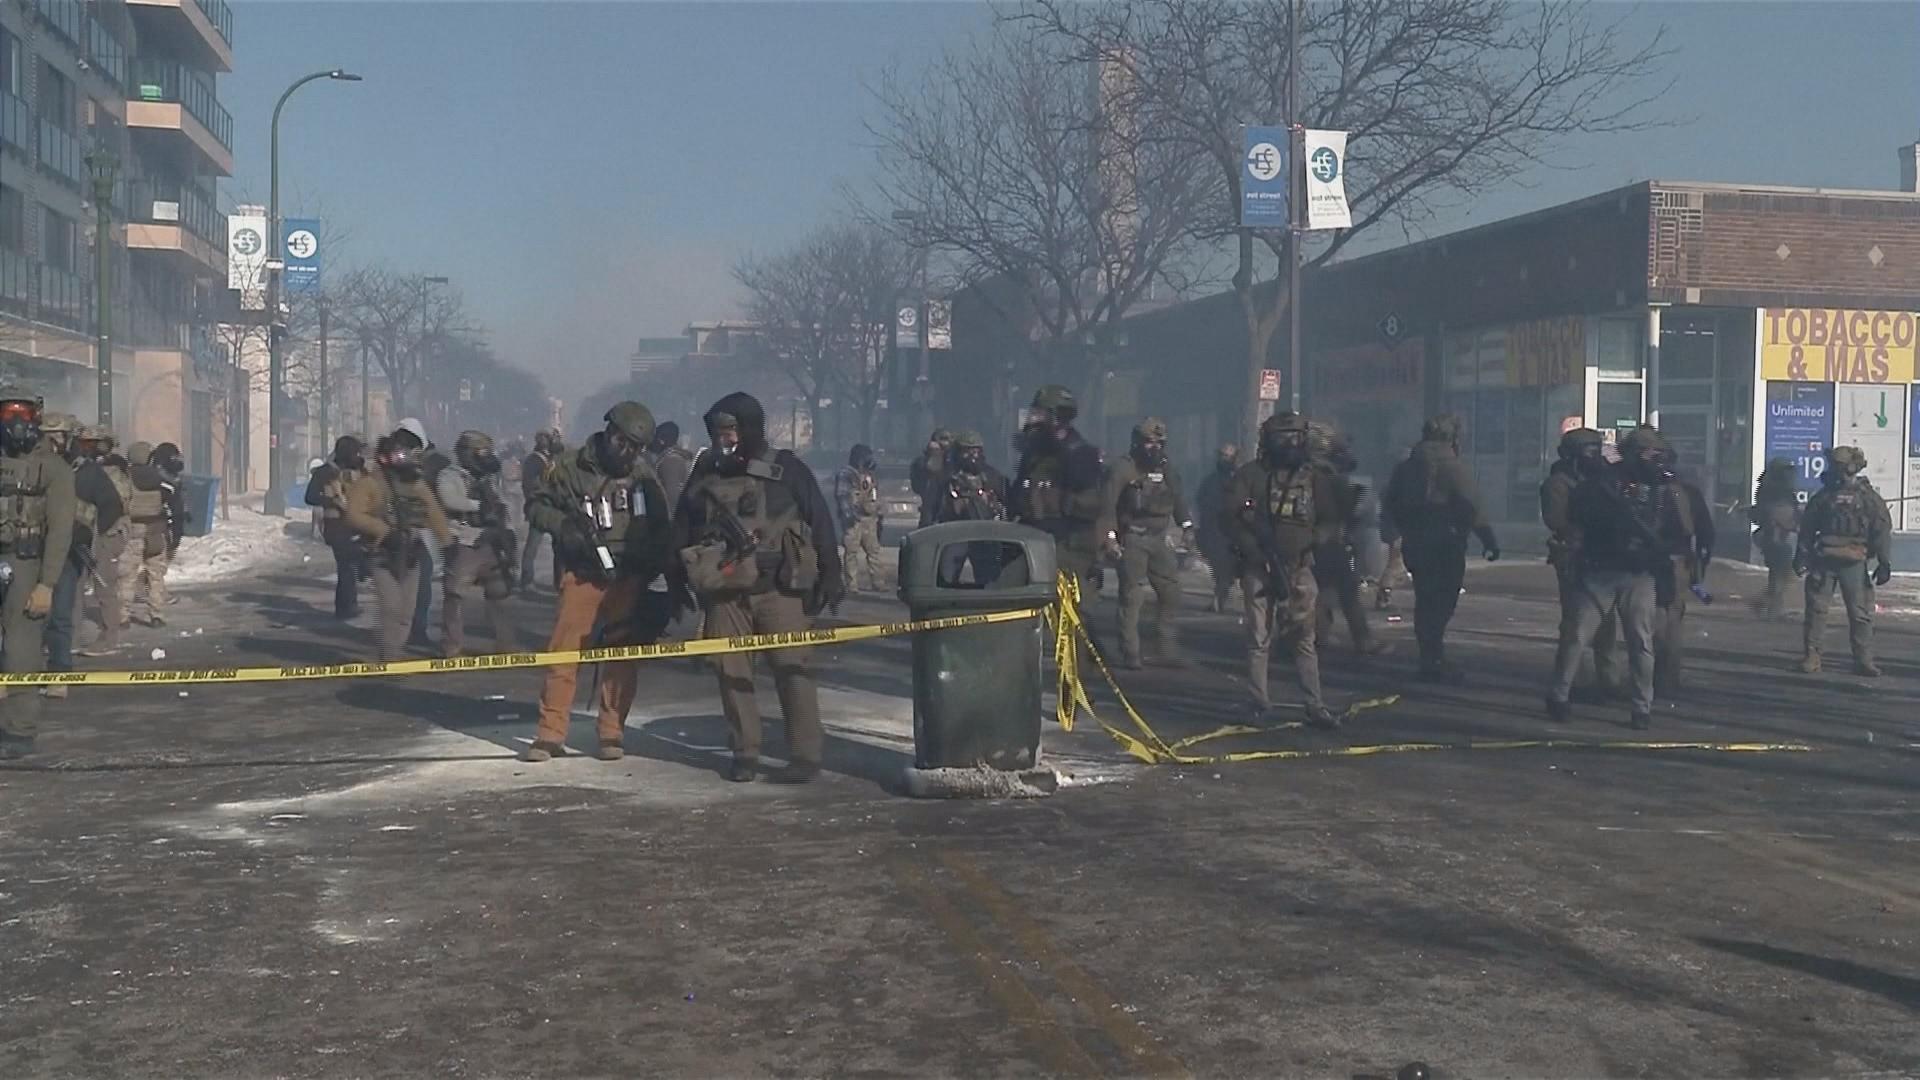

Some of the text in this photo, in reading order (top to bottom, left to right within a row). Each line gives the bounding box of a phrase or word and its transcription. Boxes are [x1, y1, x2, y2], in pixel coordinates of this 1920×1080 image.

[1386, 315, 1398, 336] 8
[1766, 308, 1914, 348] TOBACCO
[1787, 346, 1889, 383] & MAS
[1771, 404, 1824, 418] Unlimited
[1798, 456, 1825, 479] $19
[729, 635, 756, 648] POLICE
[758, 634, 775, 646] LINE
[791, 631, 807, 642] NOT
[810, 630, 836, 640] CROSS
[580, 649, 607, 660] POLICE
[608, 647, 625, 658] LINE
[641, 645, 657, 655] NOT
[129, 671, 157, 681] POLICE
[280, 666, 308, 677] POLICE
